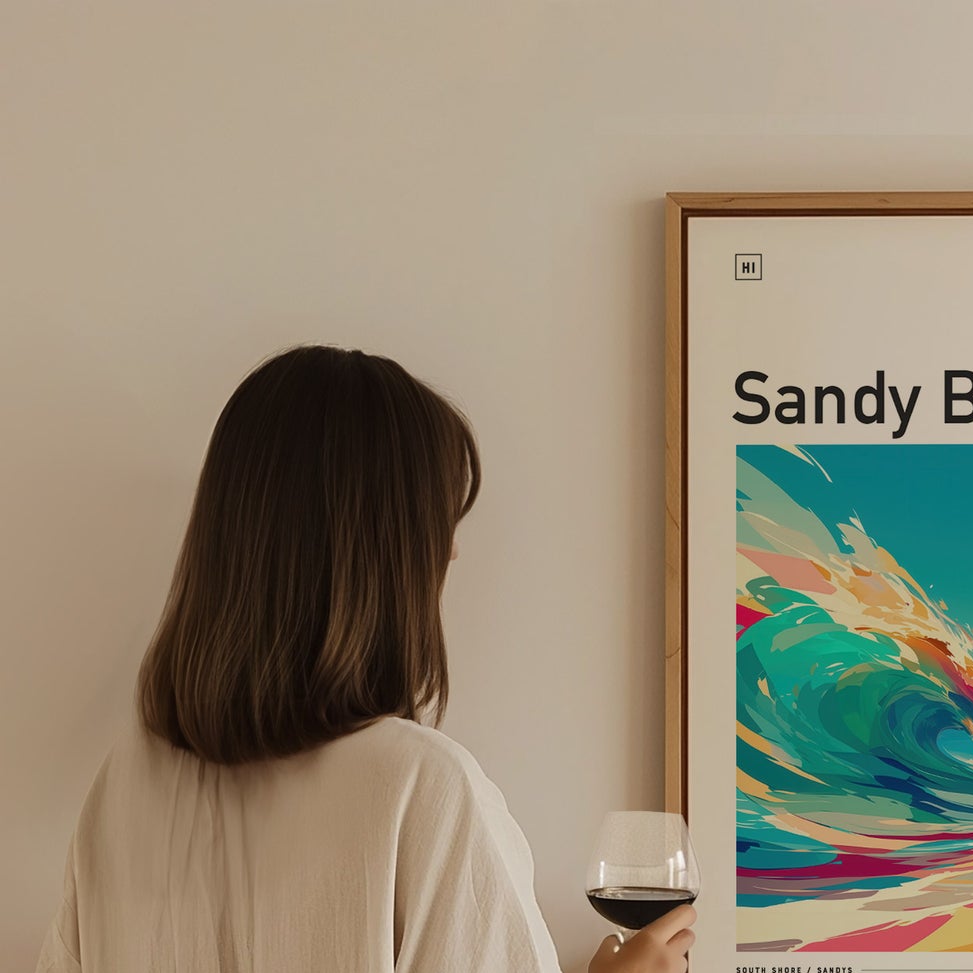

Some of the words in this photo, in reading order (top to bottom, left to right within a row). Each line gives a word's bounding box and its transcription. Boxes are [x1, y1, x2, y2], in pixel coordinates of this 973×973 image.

[742, 262, 756, 274] HI
[732, 370, 922, 440] Sandy
[736, 966, 766, 973] SOUTH
[771, 966, 802, 973] SHORE
[817, 966, 853, 973] SANDYS
